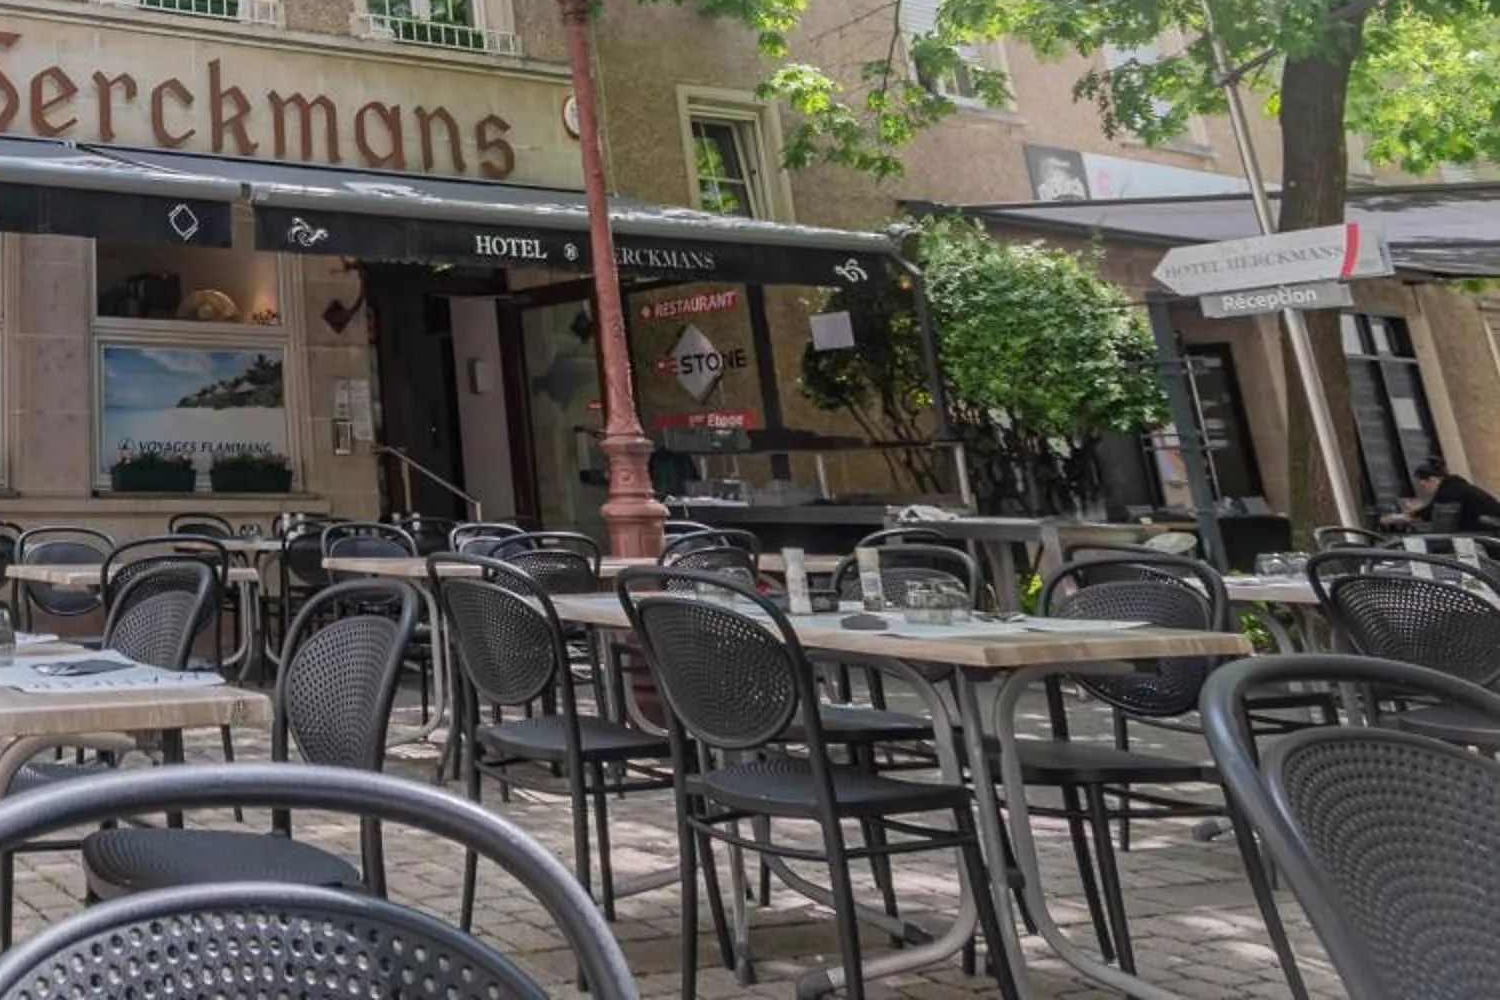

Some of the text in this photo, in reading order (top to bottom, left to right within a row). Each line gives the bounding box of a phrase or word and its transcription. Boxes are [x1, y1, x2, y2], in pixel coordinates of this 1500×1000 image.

[474, 234, 548, 260] HOTEL
[612, 246, 716, 271] ERCKMANS
[1164, 260, 1221, 280] HOTEL
[654, 290, 737, 318] RESTAURANT
[1219, 284, 1318, 313] Réception
